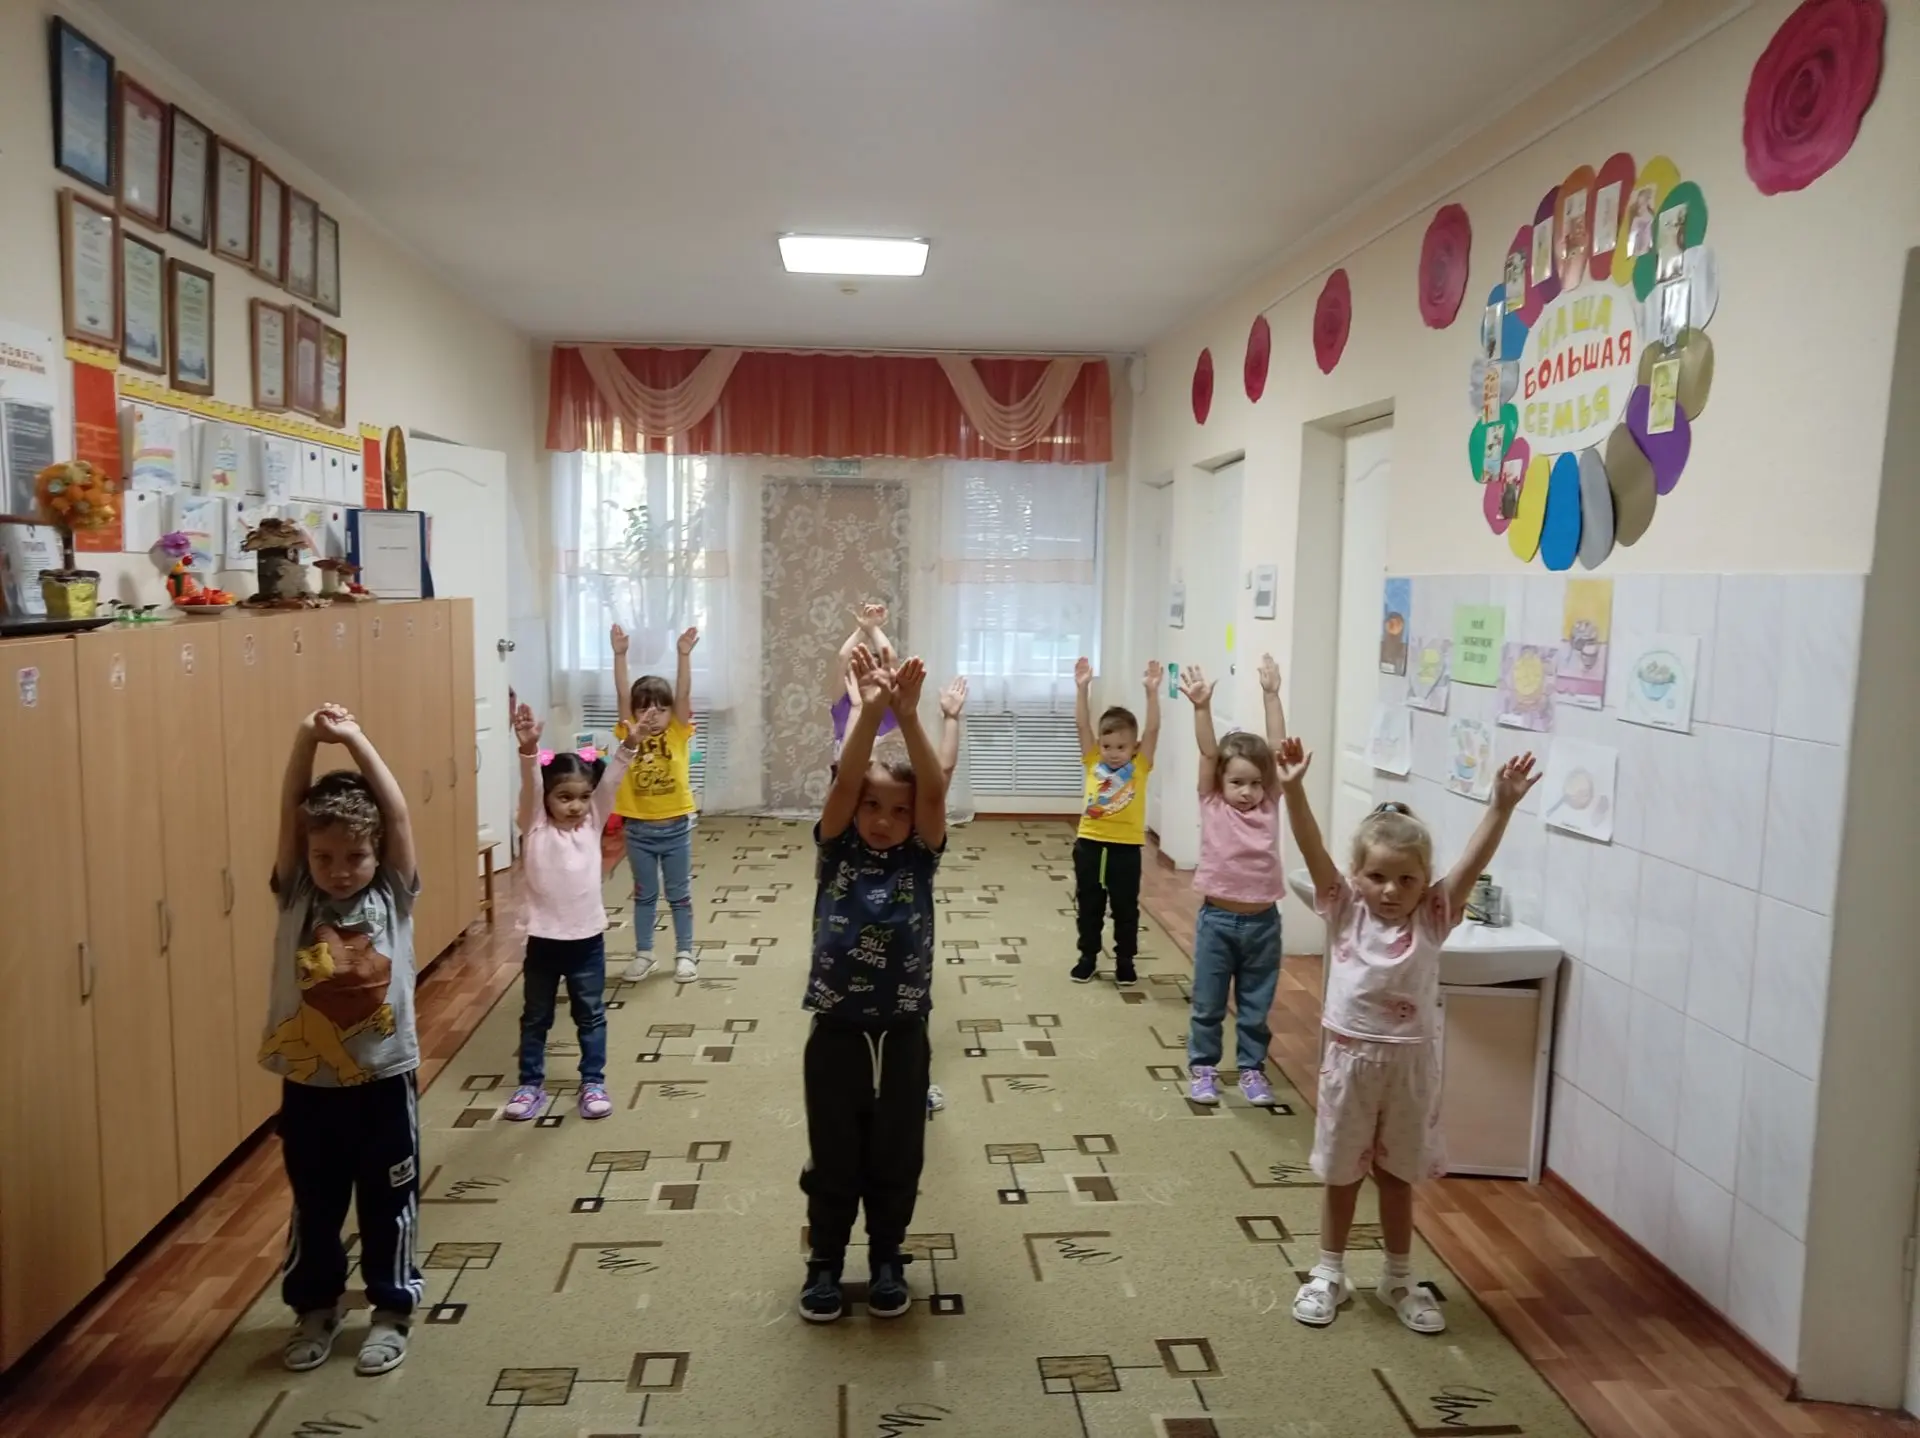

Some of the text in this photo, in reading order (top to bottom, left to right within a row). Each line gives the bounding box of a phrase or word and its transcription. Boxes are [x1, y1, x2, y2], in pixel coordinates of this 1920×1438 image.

[1537, 293, 1614, 362] НАША
[1523, 329, 1633, 401] БОЛЬШАЯ
[1523, 382, 1611, 439] СЕМЬЯ
